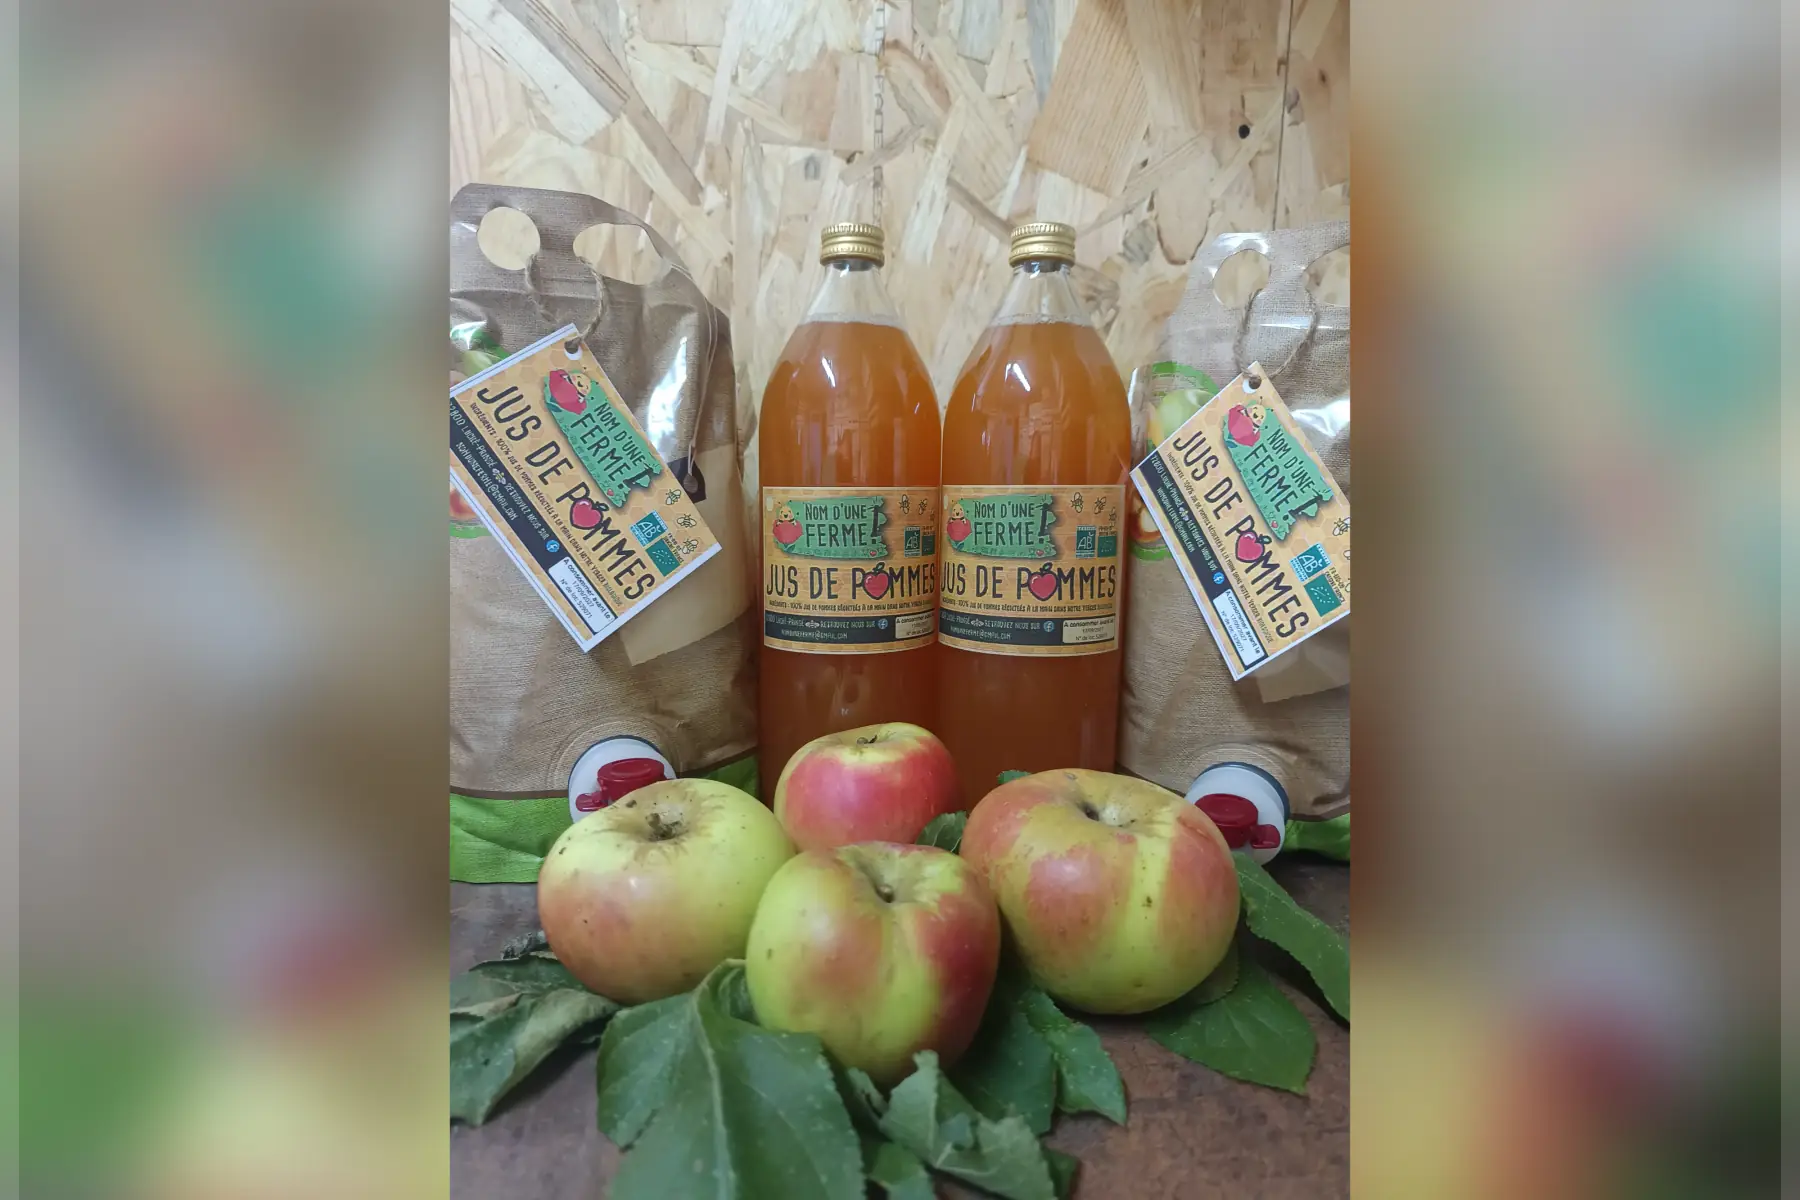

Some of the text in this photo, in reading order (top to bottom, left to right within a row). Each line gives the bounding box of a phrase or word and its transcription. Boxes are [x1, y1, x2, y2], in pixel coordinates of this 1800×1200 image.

[450, 401, 466, 426] 2800
[476, 386, 542, 441] JUS
[524, 440, 574, 486] DE
[495, 438, 512, 456] 100%
[593, 402, 646, 467] NOM D'UNE
[1172, 430, 1219, 482] JUS
[1203, 476, 1243, 520] DE
[1266, 428, 1315, 494] NOM D'UNE
[805, 503, 868, 521] NOM D'UNE
[974, 500, 1035, 519] NOM D'UNE
[637, 521, 660, 538] AB
[1077, 536, 1093, 550] AB
[1298, 555, 1321, 573] AB
[567, 564, 594, 596] consommer
[766, 564, 798, 598] JUS
[809, 567, 839, 600] DE
[941, 561, 966, 596] JUS
[975, 565, 1004, 599] DE
